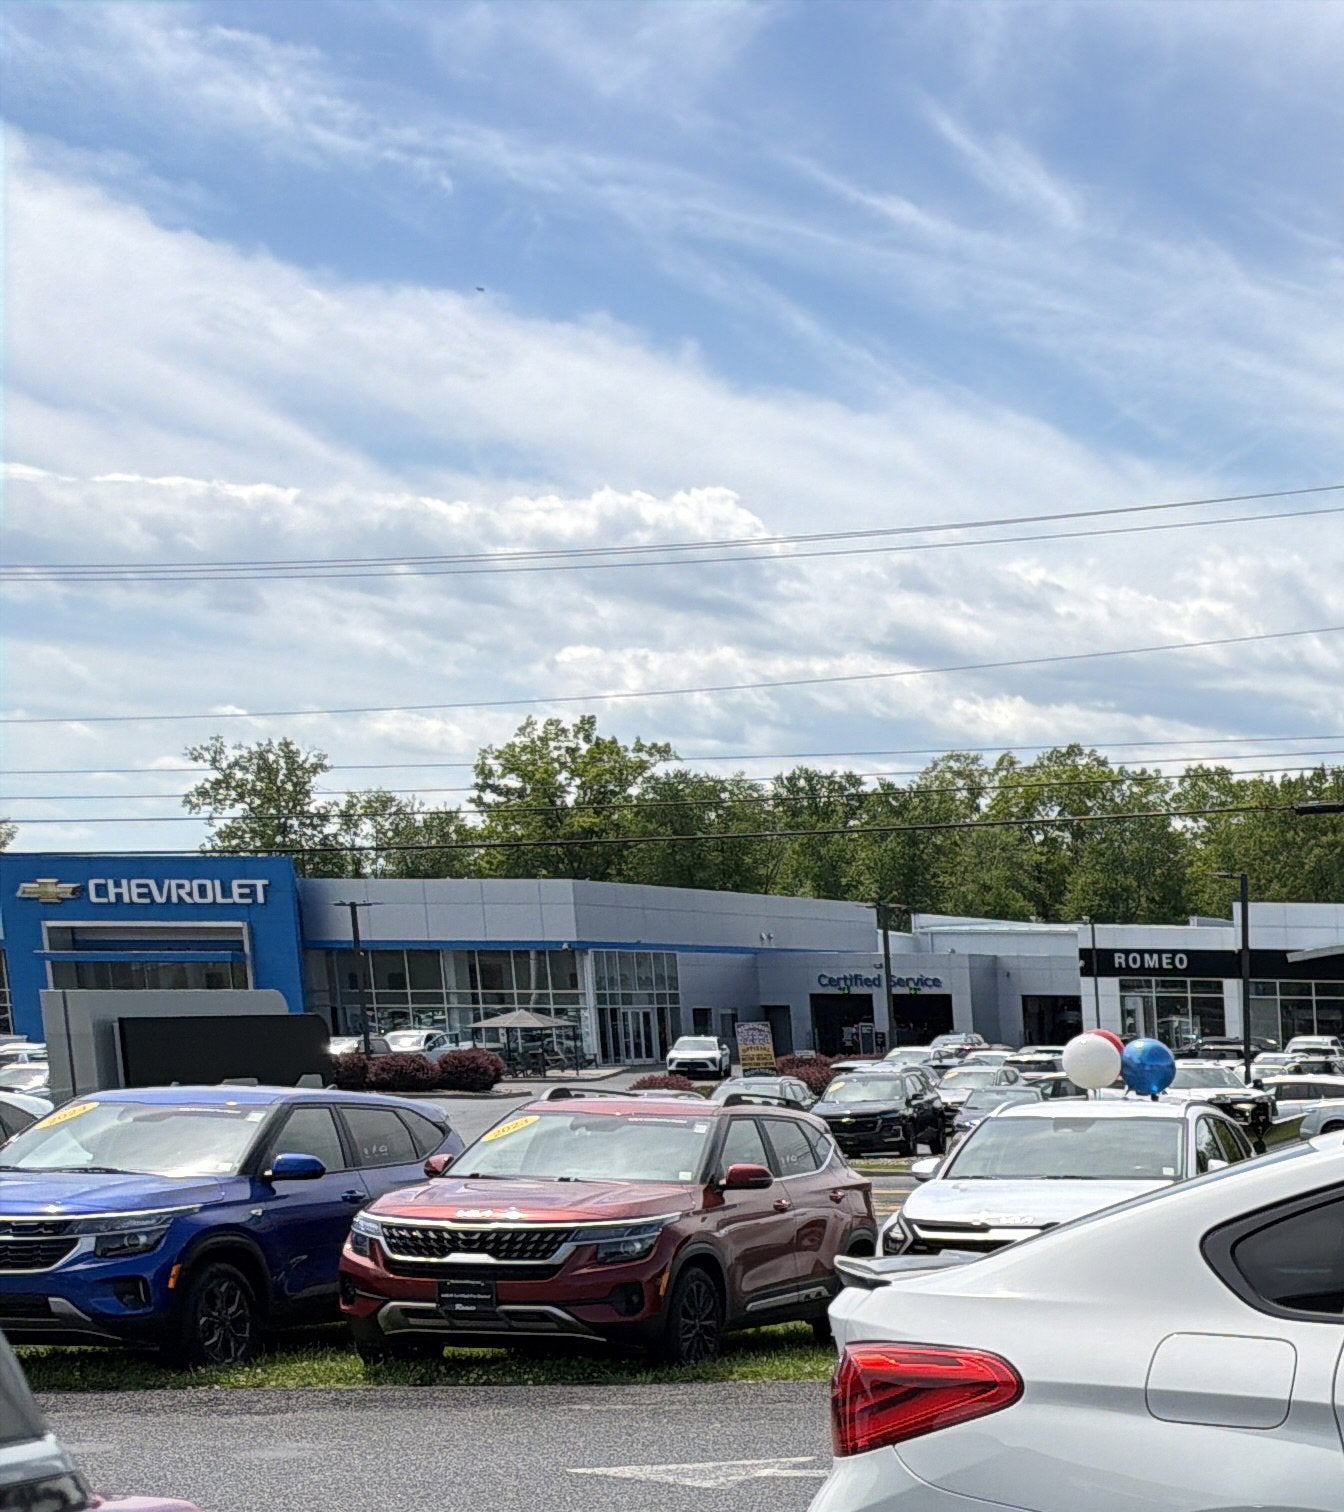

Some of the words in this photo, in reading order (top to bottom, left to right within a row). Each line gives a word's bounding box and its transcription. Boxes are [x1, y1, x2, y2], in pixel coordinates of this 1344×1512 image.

[88, 878, 269, 904] CHEVROLET
[1113, 952, 1188, 969] ROMEO
[817, 973, 882, 988] Certified
[889, 974, 943, 988] Service
